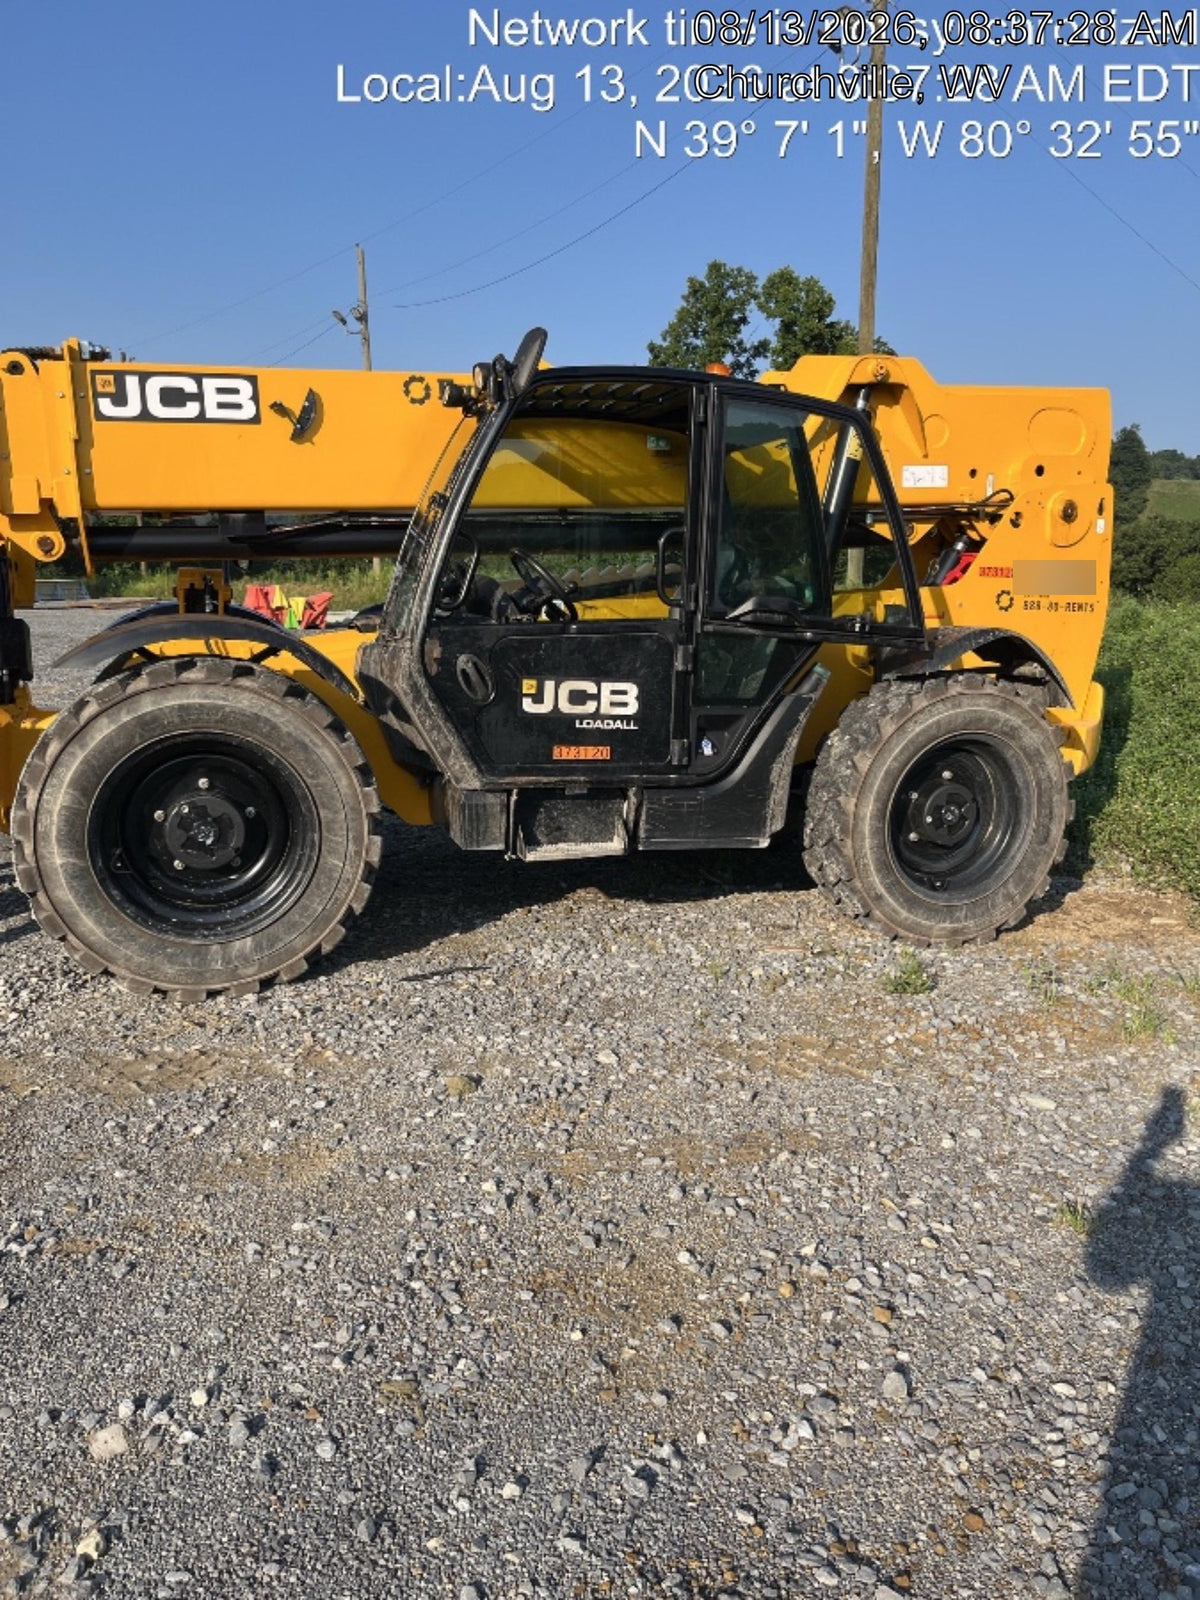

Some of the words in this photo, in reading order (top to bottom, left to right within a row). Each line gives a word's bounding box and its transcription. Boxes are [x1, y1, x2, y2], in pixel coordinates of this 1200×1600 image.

[96, 374, 257, 420] JCB
[522, 679, 639, 716] JCB
[575, 719, 639, 730] LOADALL
[553, 745, 611, 760] 373120
